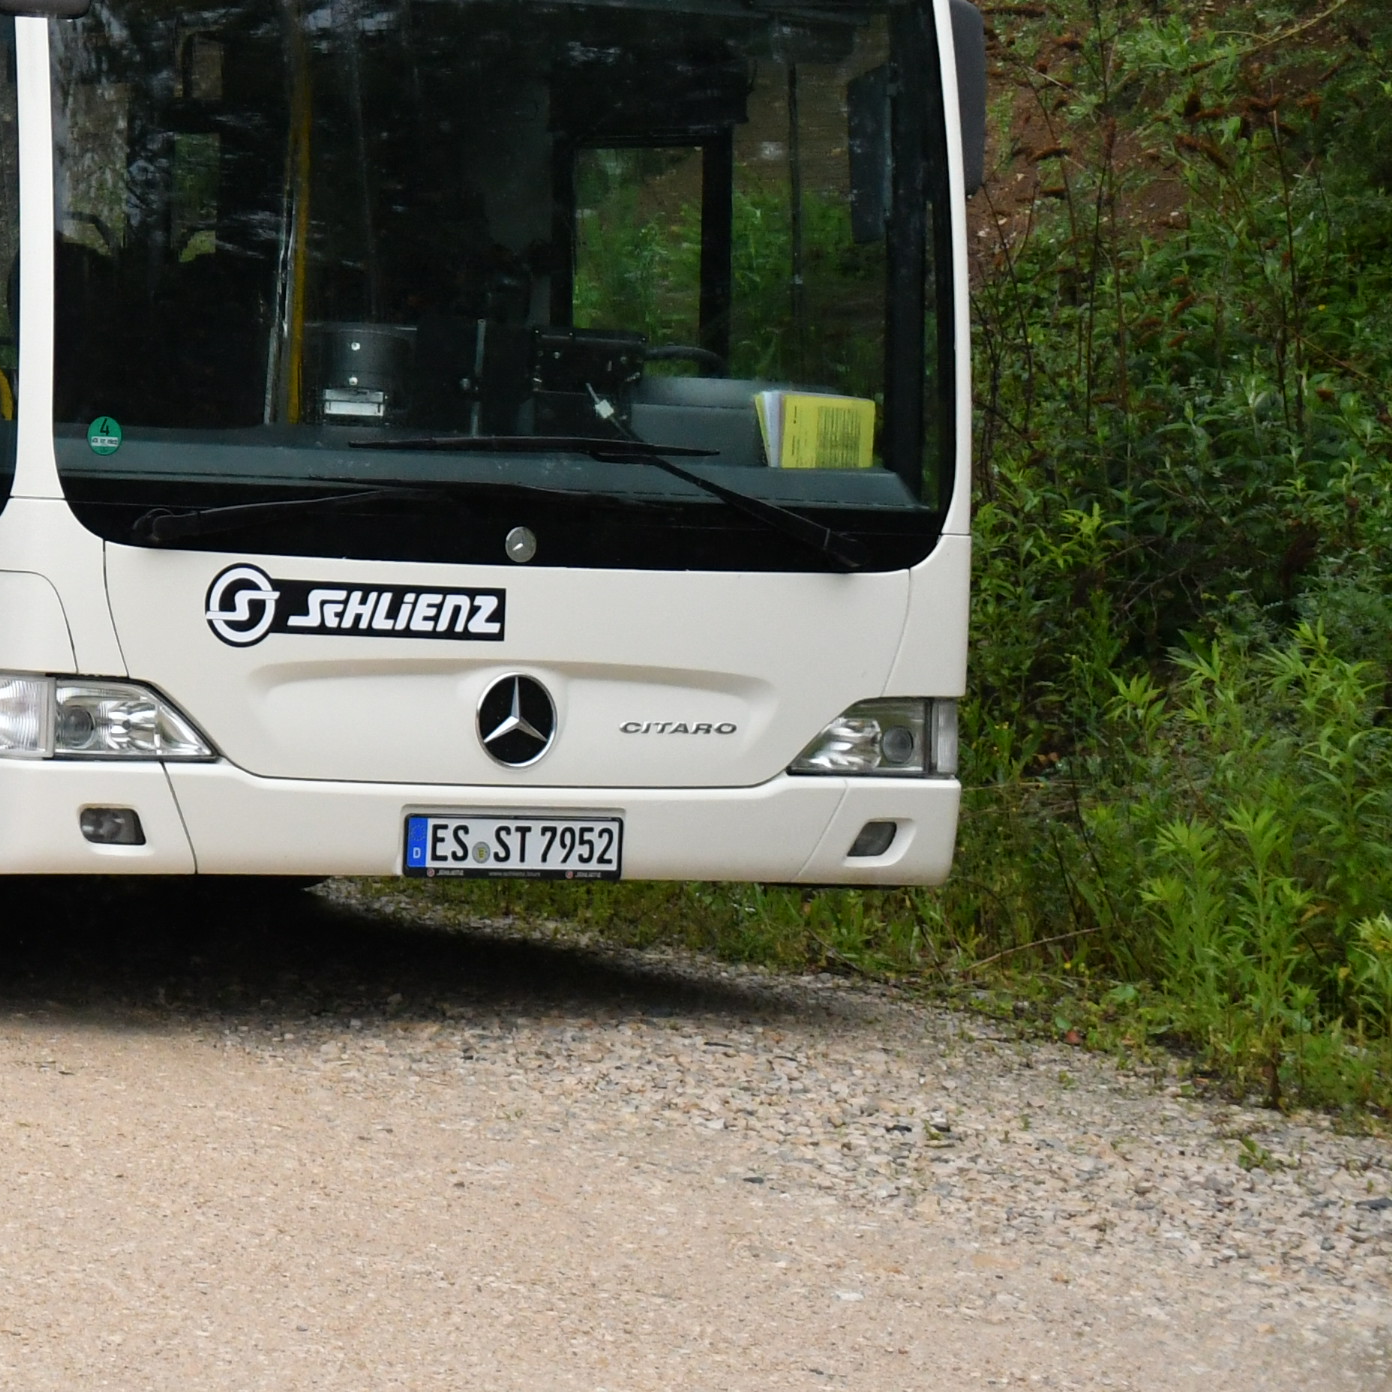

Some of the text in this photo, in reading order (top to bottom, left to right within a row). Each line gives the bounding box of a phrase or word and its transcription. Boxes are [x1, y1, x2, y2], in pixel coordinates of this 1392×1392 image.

[99, 417, 111, 436] 4
[618, 720, 738, 735] CITARO
[430, 823, 470, 862] ES
[493, 825, 533, 864] ST
[540, 825, 615, 865] 7952
